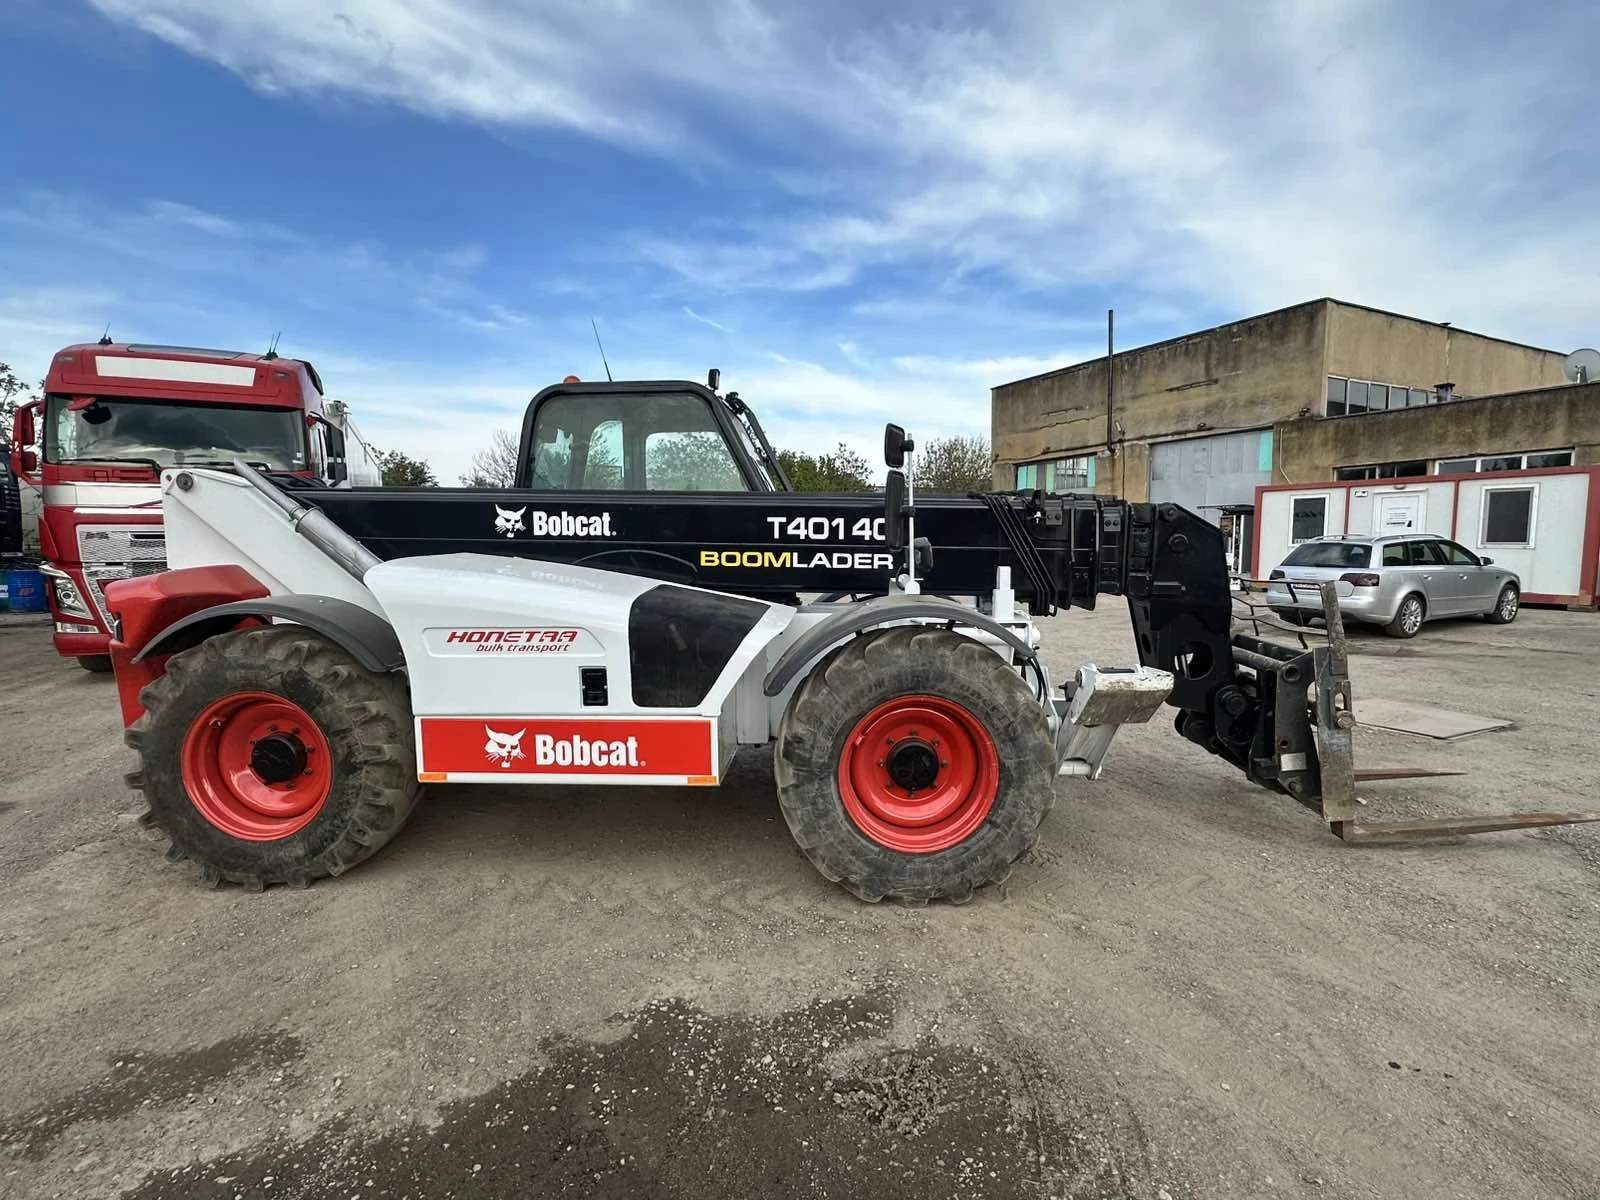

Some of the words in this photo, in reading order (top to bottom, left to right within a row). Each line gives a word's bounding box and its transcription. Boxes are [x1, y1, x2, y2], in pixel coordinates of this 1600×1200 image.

[700, 550, 894, 569] BOOMLADER
[475, 643, 503, 652] bulk
[507, 643, 570, 653] transport
